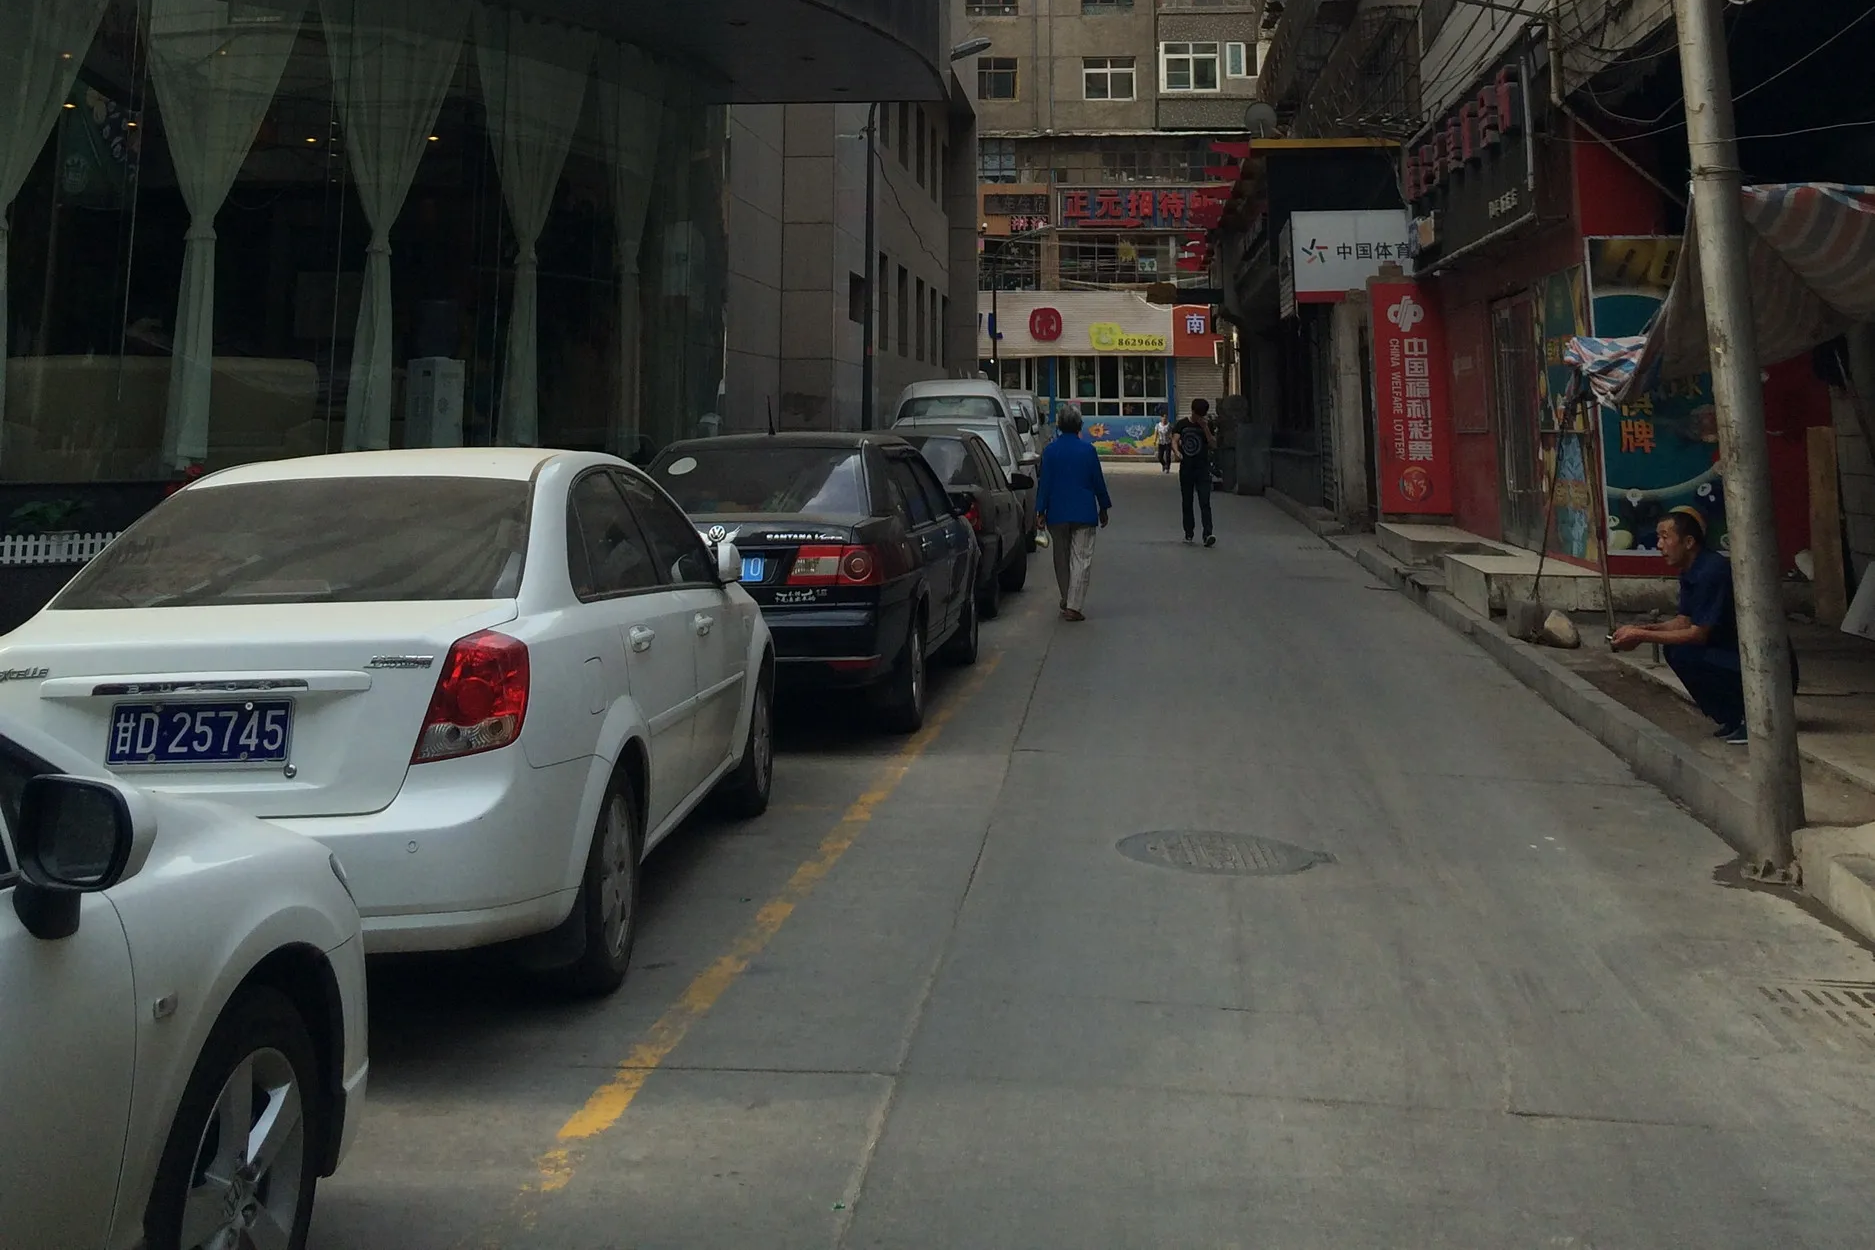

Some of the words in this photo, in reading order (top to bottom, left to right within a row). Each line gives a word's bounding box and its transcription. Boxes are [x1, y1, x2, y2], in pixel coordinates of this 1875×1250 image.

[1336, 241, 1411, 260] 中国体育
[1185, 312, 1206, 335] 南
[1117, 337, 1165, 348] 8629668
[1388, 338, 1400, 368] CHINA
[1390, 371, 1404, 415] WELFARE
[1403, 337, 1434, 461] 中国福利彩票
[1392, 419, 1406, 461] LOTTERY
